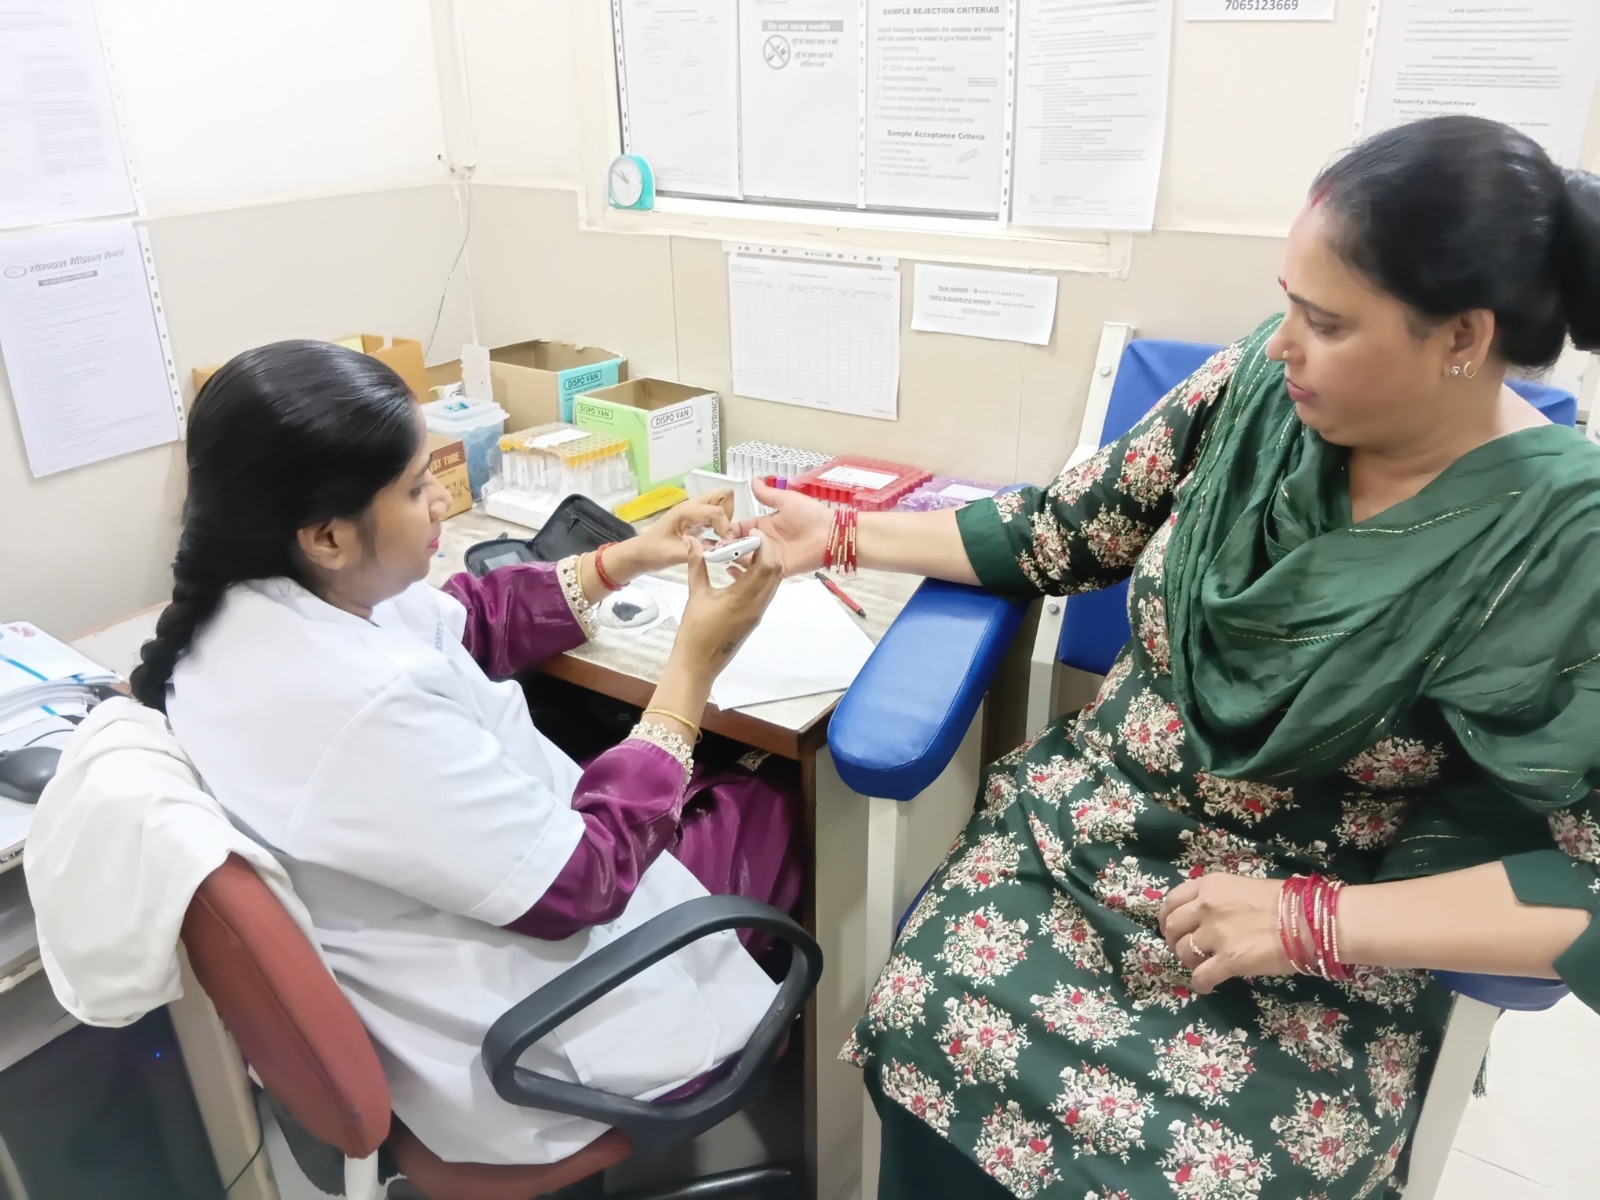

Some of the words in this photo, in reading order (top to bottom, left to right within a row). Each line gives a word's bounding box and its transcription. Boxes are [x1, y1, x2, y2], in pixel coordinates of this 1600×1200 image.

[957, 6, 1000, 14] CRITERIAS
[1226, 0, 1298, 10] 7065123669
[1427, 99, 1476, 107] Objectives
[887, 130, 912, 138] Sample
[914, 130, 956, 139] Acceptance
[958, 132, 985, 140] Criteria
[568, 376, 585, 388] DISPO
[586, 372, 598, 382] VAN
[580, 405, 596, 415] DISPO
[597, 408, 609, 417] VAN
[655, 414, 674, 426] DISPO
[675, 409, 689, 419] VAN
[429, 458, 442, 472] EST
[443, 452, 461, 466] TUBE
